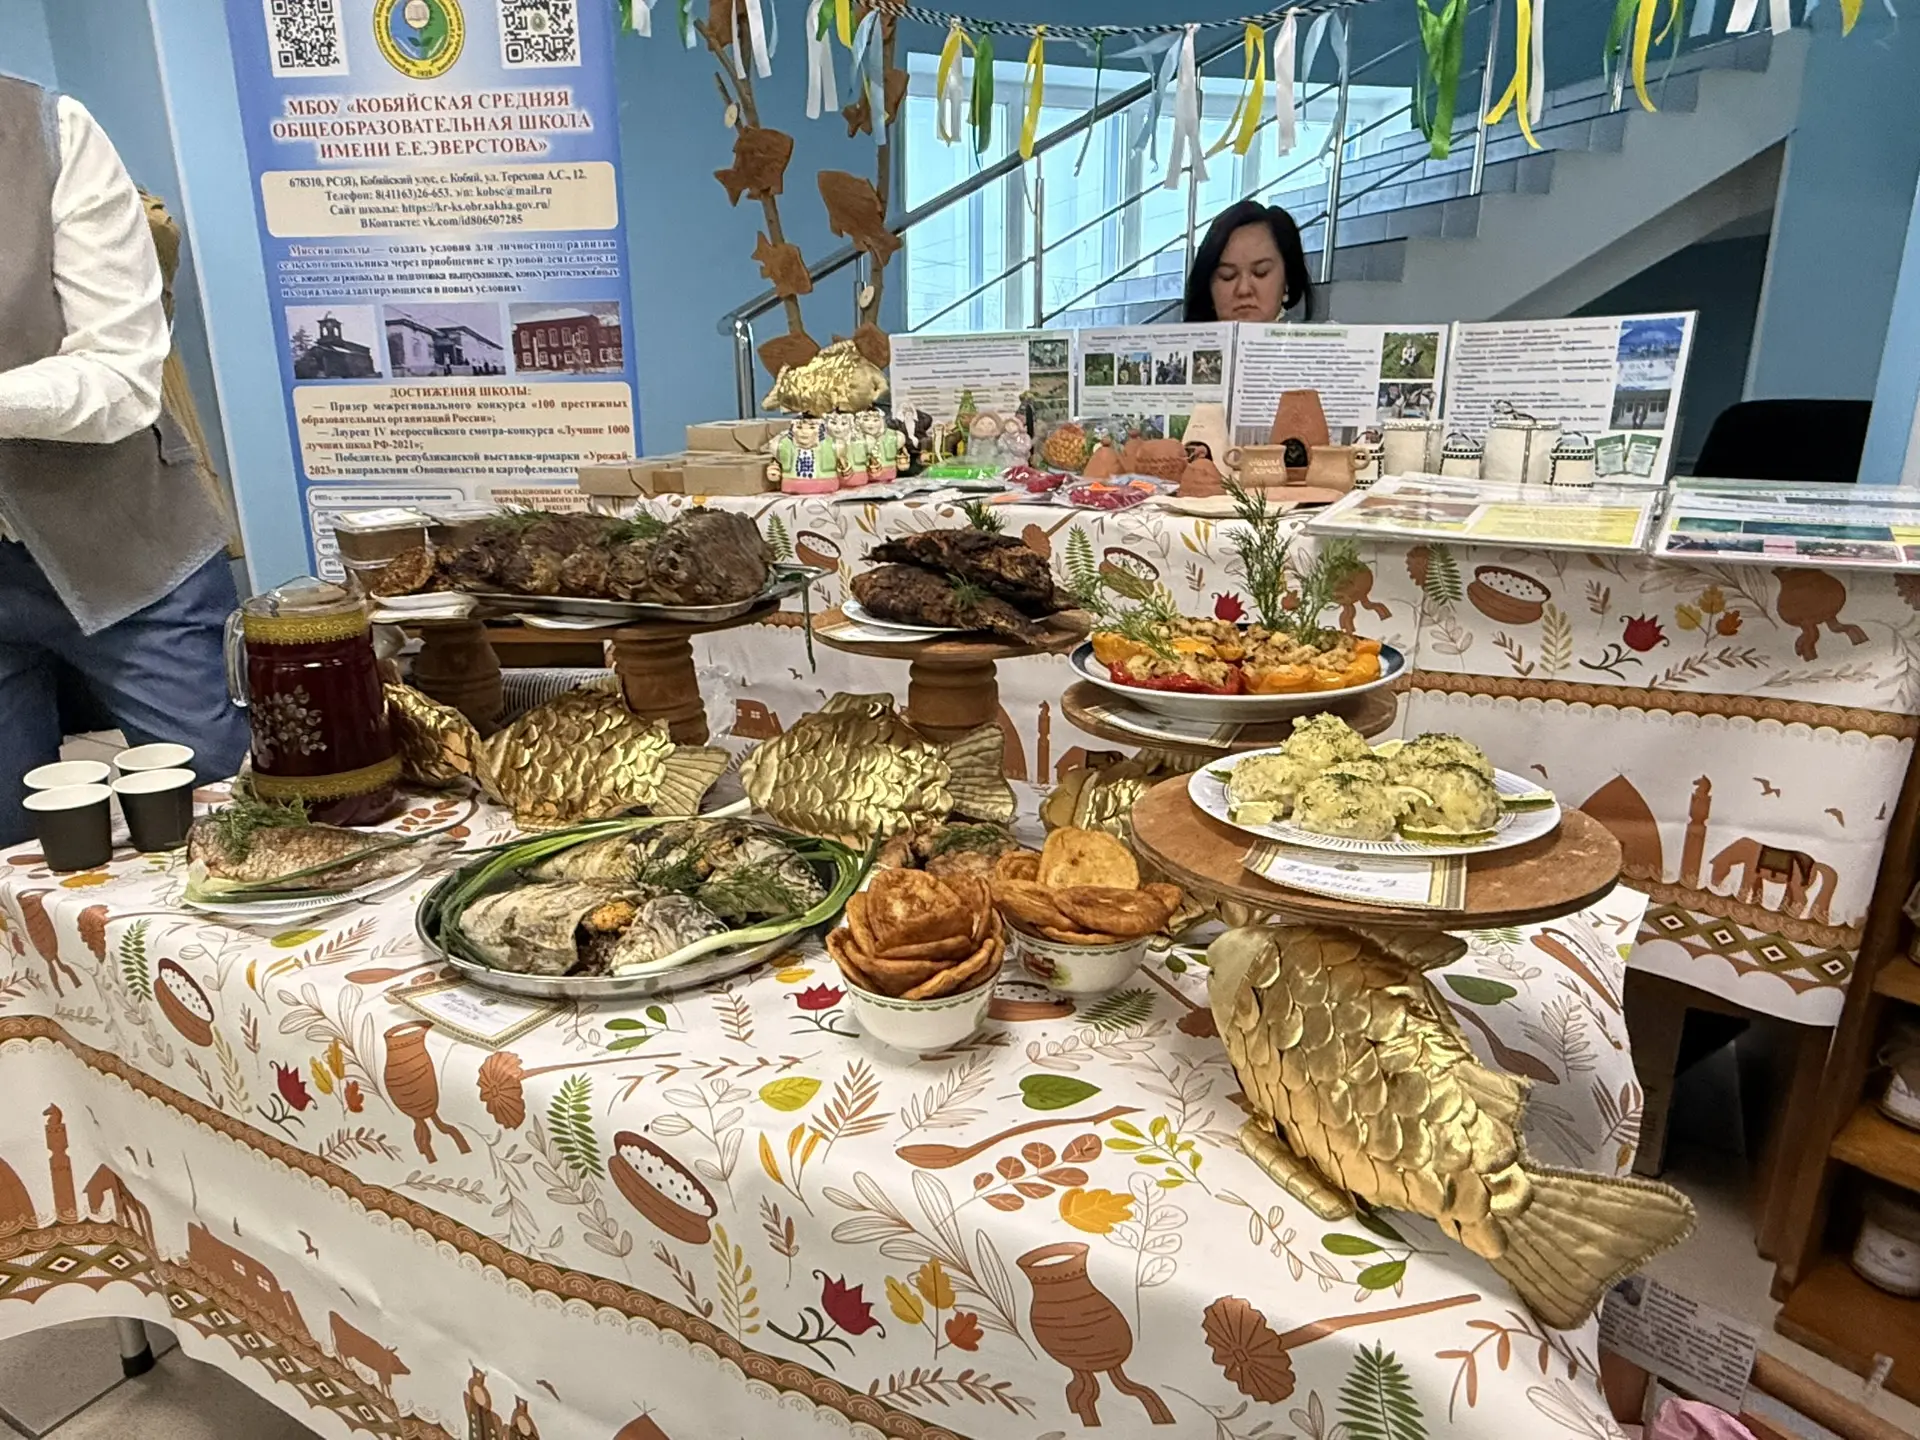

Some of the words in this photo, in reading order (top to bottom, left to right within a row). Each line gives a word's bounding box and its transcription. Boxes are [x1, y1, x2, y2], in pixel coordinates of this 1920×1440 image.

[288, 99, 340, 115] МБОУ
[347, 93, 473, 113] «КОБЯЙСКАЯ
[478, 91, 570, 110] СРЕДНЯЯ
[273, 116, 513, 139] ОБЩЕОБРАЗОВАТЕЛЬНАЯ
[518, 113, 591, 130] ШКОЛА
[320, 142, 391, 158] ИМЕНИ
[396, 137, 548, 157] Е.Е.ЭВЕРСТОВА»
[326, 175, 359, 187] РС(Я),
[360, 174, 413, 186] Кобяйский
[500, 171, 545, 184] Терехова
[325, 190, 373, 202] Телефон:
[329, 204, 356, 216] Сайт
[359, 204, 399, 215] школы:
[360, 216, 420, 229] ВКонтакте:
[388, 245, 427, 254] создать
[430, 243, 471, 256] условия
[475, 243, 493, 252] для
[497, 242, 563, 252] личностного
[566, 241, 617, 254] развития
[330, 259, 389, 270] школьника
[391, 258, 419, 270] через
[421, 256, 485, 270] приобщение
[498, 255, 543, 267] трудовой
[547, 254, 618, 264] деятельности
[442, 285, 474, 294] новых
[390, 387, 476, 398] ДОСТИЖЕНИЯ
[479, 385, 532, 397] ШКОЛЫ:
[330, 402, 368, 414] Призер
[373, 401, 472, 413] межрегионального
[477, 401, 526, 412] конкурса
[531, 399, 555, 409] «100
[560, 398, 628, 411] престижных
[301, 414, 386, 426] образовательных
[387, 413, 450, 425] организаций
[452, 412, 496, 424] России»;
[331, 427, 370, 439] Лауреат
[374, 427, 386, 436] IV
[390, 426, 467, 437] всероссийского
[469, 425, 554, 438] смотра-конкурса
[557, 424, 604, 437] «Лучшие
[607, 424, 630, 434] 1000
[305, 441, 343, 452] лучших
[345, 441, 372, 450] школ
[373, 439, 425, 451] РФ-2021»;
[335, 453, 392, 463] Победитель
[395, 451, 480, 463] республиканской
[483, 450, 580, 463] выставки-ярмарки
[583, 449, 632, 463] «Урожай-
[309, 465, 336, 475] 2023»
[338, 466, 344, 474] в
[345, 464, 409, 477] направлении
[410, 463, 487, 475] «Овощеводство
[488, 464, 495, 474] и
